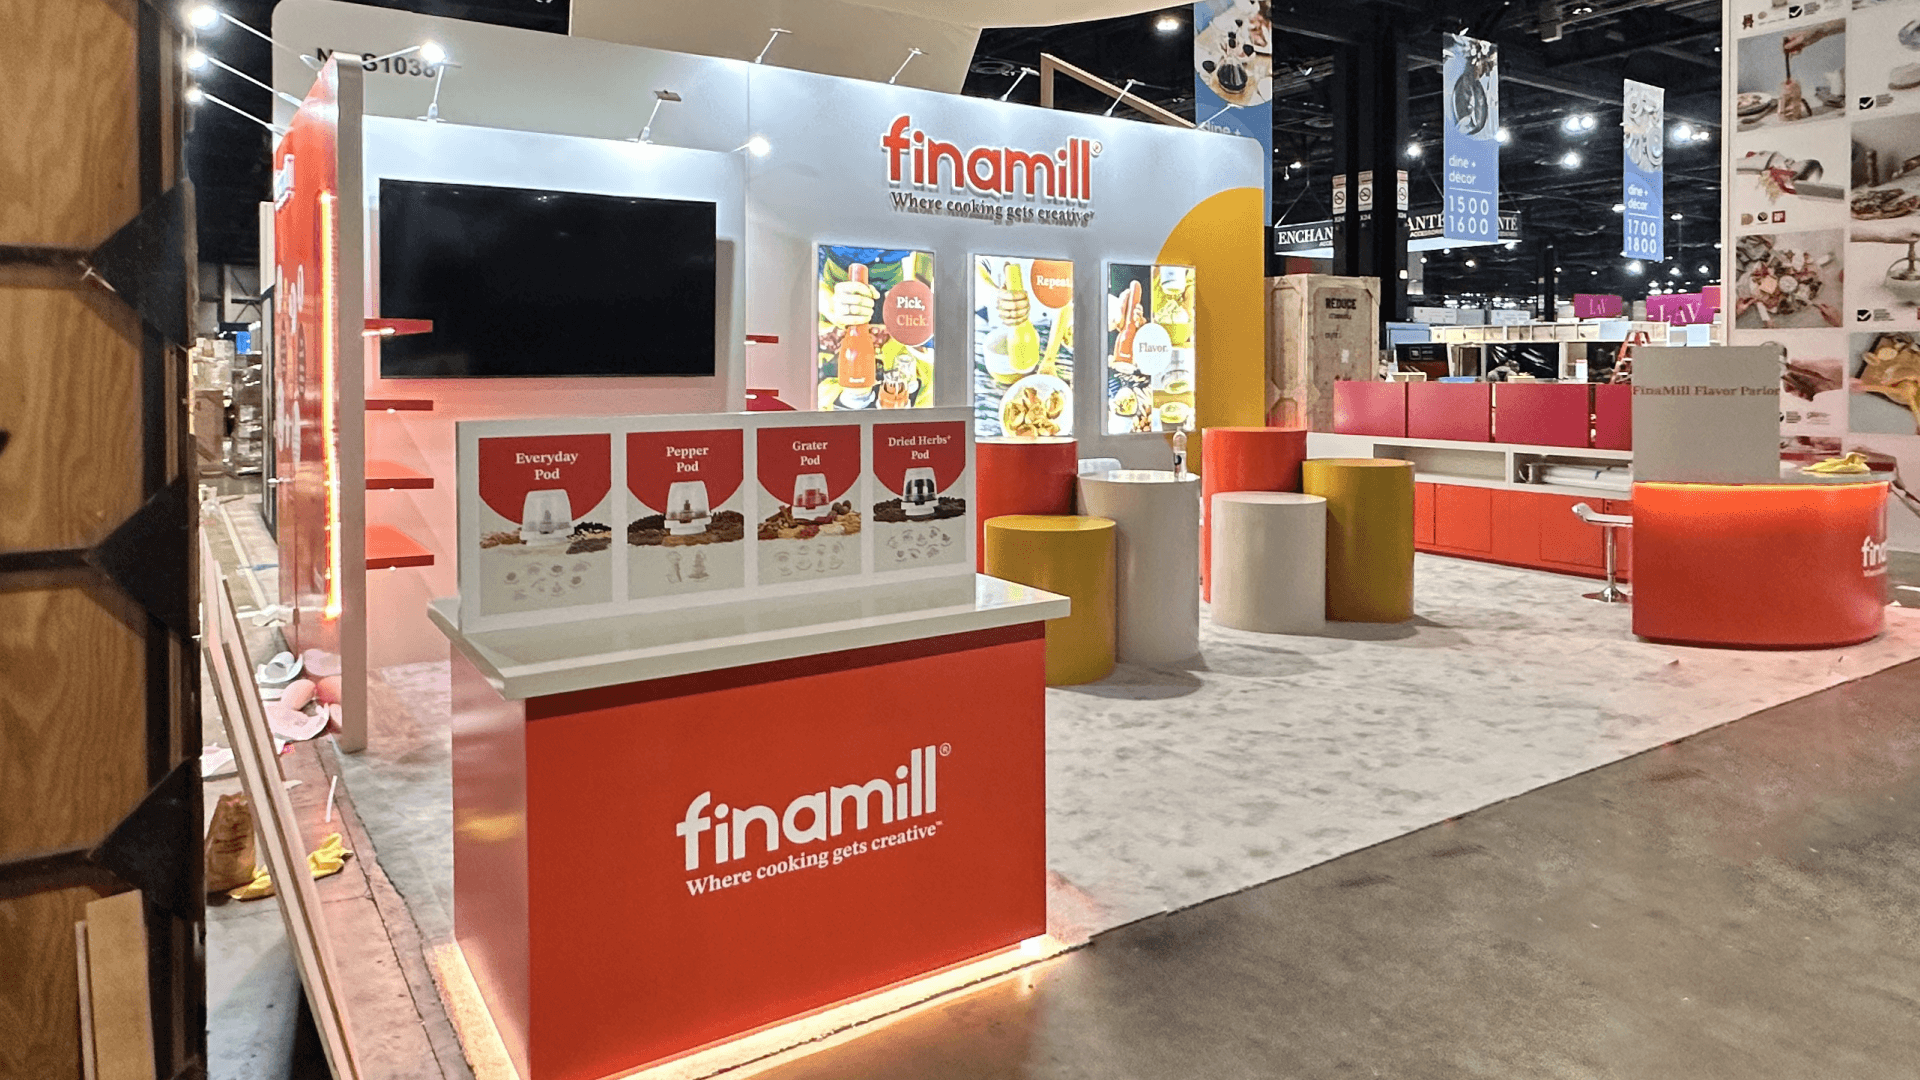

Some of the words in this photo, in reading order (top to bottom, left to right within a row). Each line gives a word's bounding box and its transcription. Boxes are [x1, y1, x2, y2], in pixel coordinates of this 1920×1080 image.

[1449, 155, 1469, 168] dine
[890, 191, 943, 212] Where
[946, 199, 1003, 219] cooking
[1006, 206, 1034, 223] gets
[1449, 195, 1489, 215] 1500
[1449, 215, 1489, 235] 1600
[1628, 219, 1657, 237] 1700
[1627, 236, 1657, 254] 1800
[897, 296, 925, 311] Pick,
[1139, 342, 1169, 353] Flavor.
[1632, 386, 1690, 396] FinaMill
[1694, 386, 1737, 396] Flavor
[1740, 386, 1781, 396] Parlor
[792, 440, 828, 451] Grater
[888, 436, 916, 447] Dried
[515, 451, 578, 465] Everyday
[666, 446, 709, 459] Pepper
[911, 450, 930, 460] Pod
[676, 461, 699, 472] Pod
[800, 455, 821, 466] Pod
[534, 468, 560, 480] Pod
[686, 867, 752, 896] Where
[756, 851, 829, 880] cooking
[832, 839, 868, 865] gets
